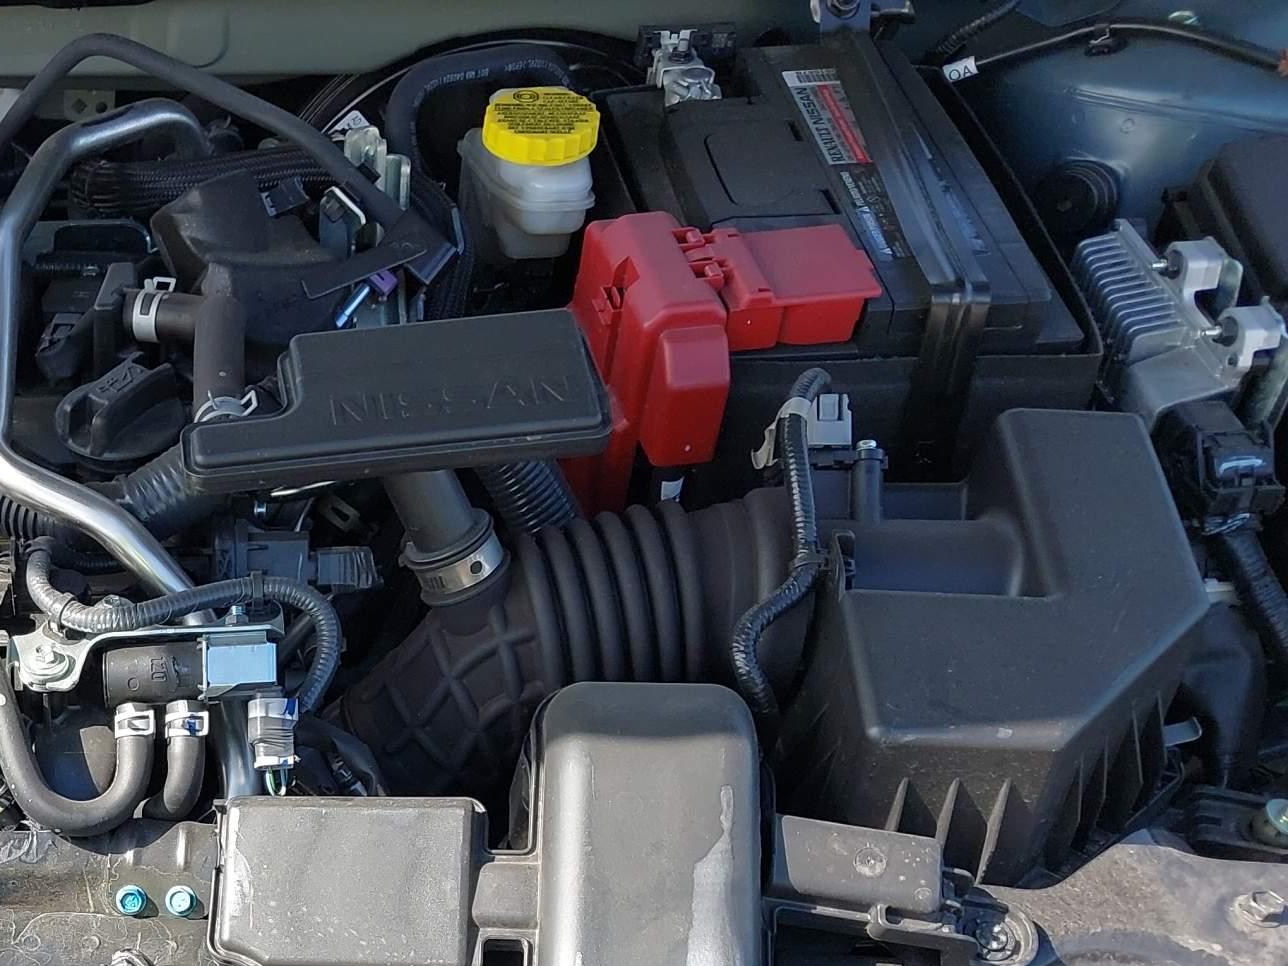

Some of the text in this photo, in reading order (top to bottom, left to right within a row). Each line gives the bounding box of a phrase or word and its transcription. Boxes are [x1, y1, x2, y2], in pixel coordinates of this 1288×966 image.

[793, 86, 846, 163] RENAULT NISSAN
[328, 376, 570, 426] NISSAN
